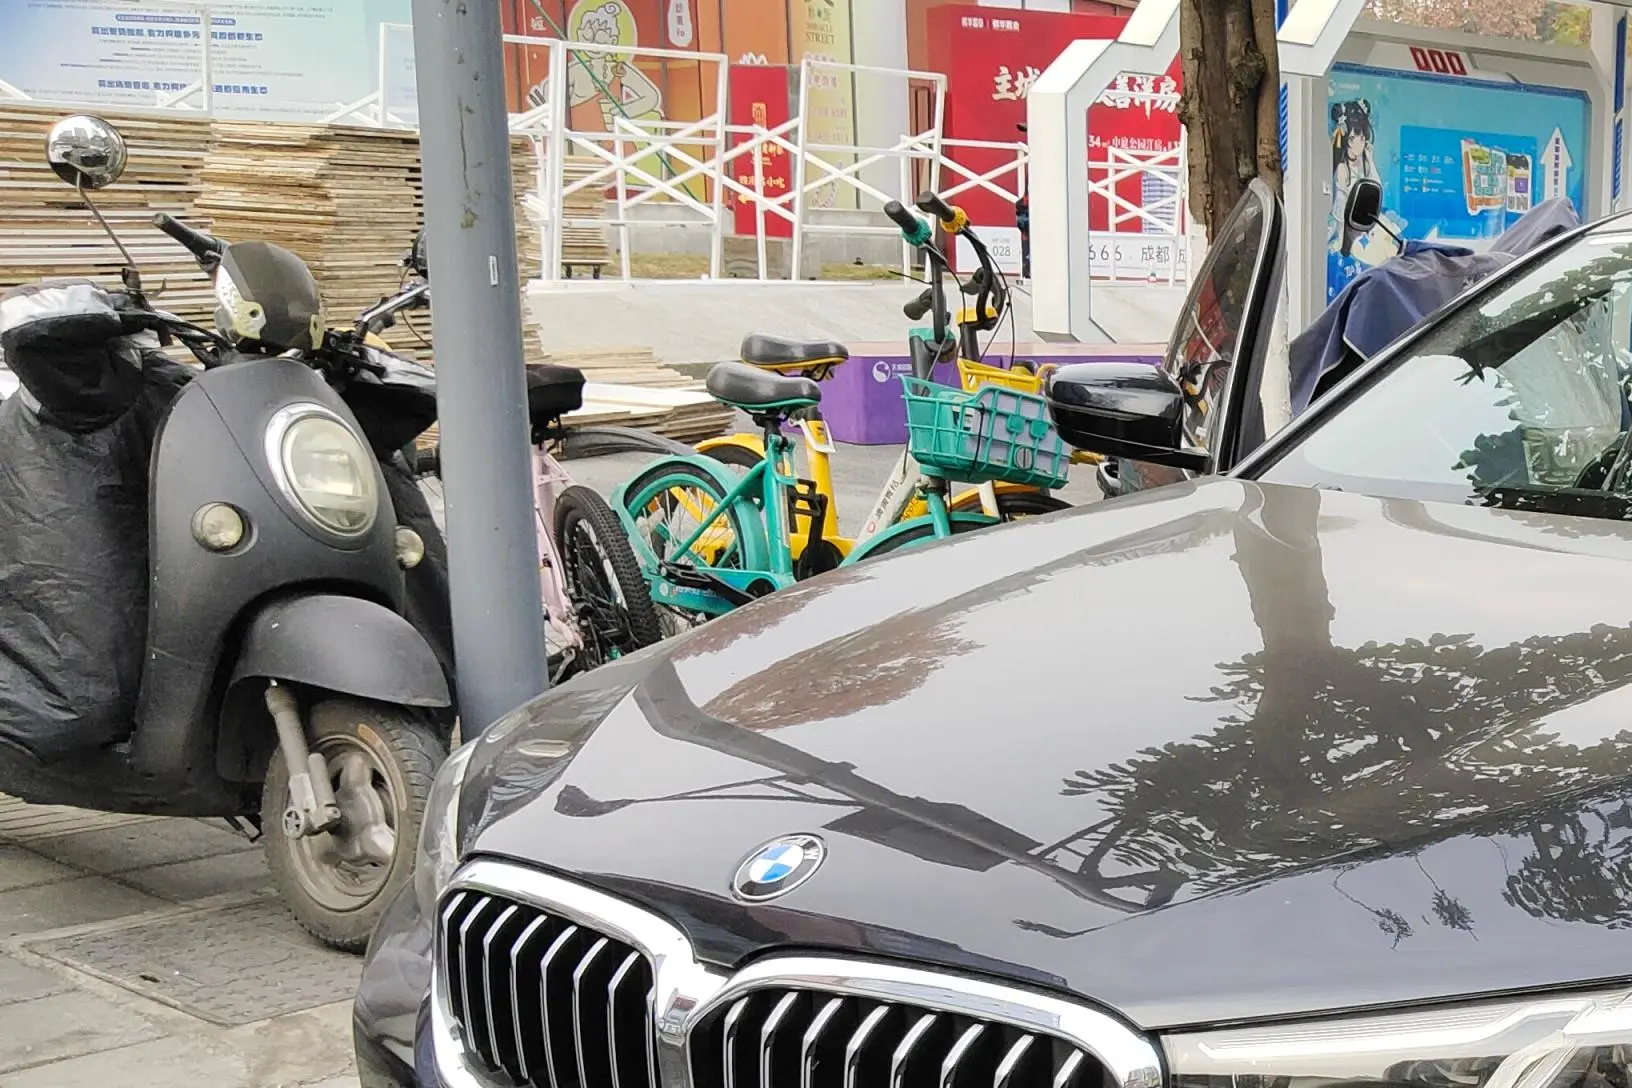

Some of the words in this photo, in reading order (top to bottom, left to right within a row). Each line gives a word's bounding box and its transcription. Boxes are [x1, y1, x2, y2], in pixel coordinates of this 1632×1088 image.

[806, 32, 835, 45] STREET
[1096, 75, 1182, 120] 善洋房
[992, 245, 1011, 257] 028
[1140, 244, 1171, 262] 成都
